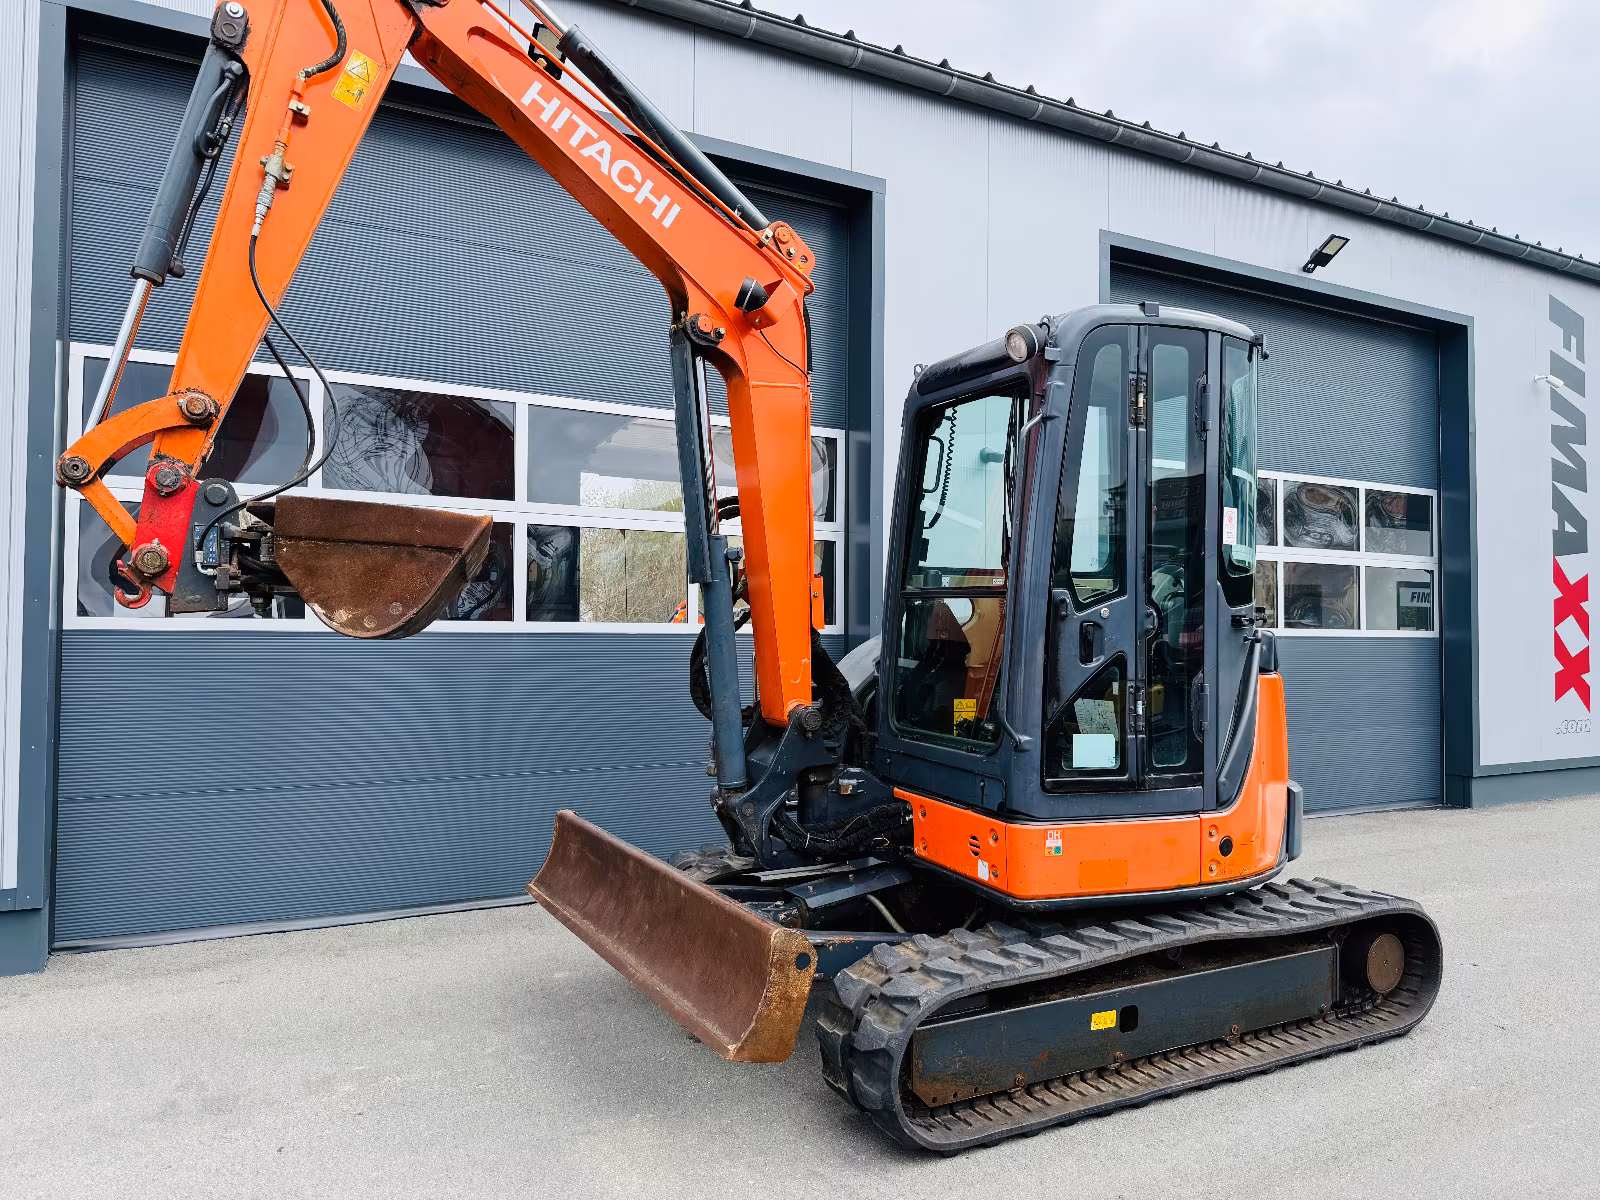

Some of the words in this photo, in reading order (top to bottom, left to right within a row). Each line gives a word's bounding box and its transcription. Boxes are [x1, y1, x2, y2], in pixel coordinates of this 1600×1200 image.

[520, 80, 682, 229] HITACHI
[1549, 293, 1591, 713] FIMAXX
[1555, 718, 1591, 735] .com
